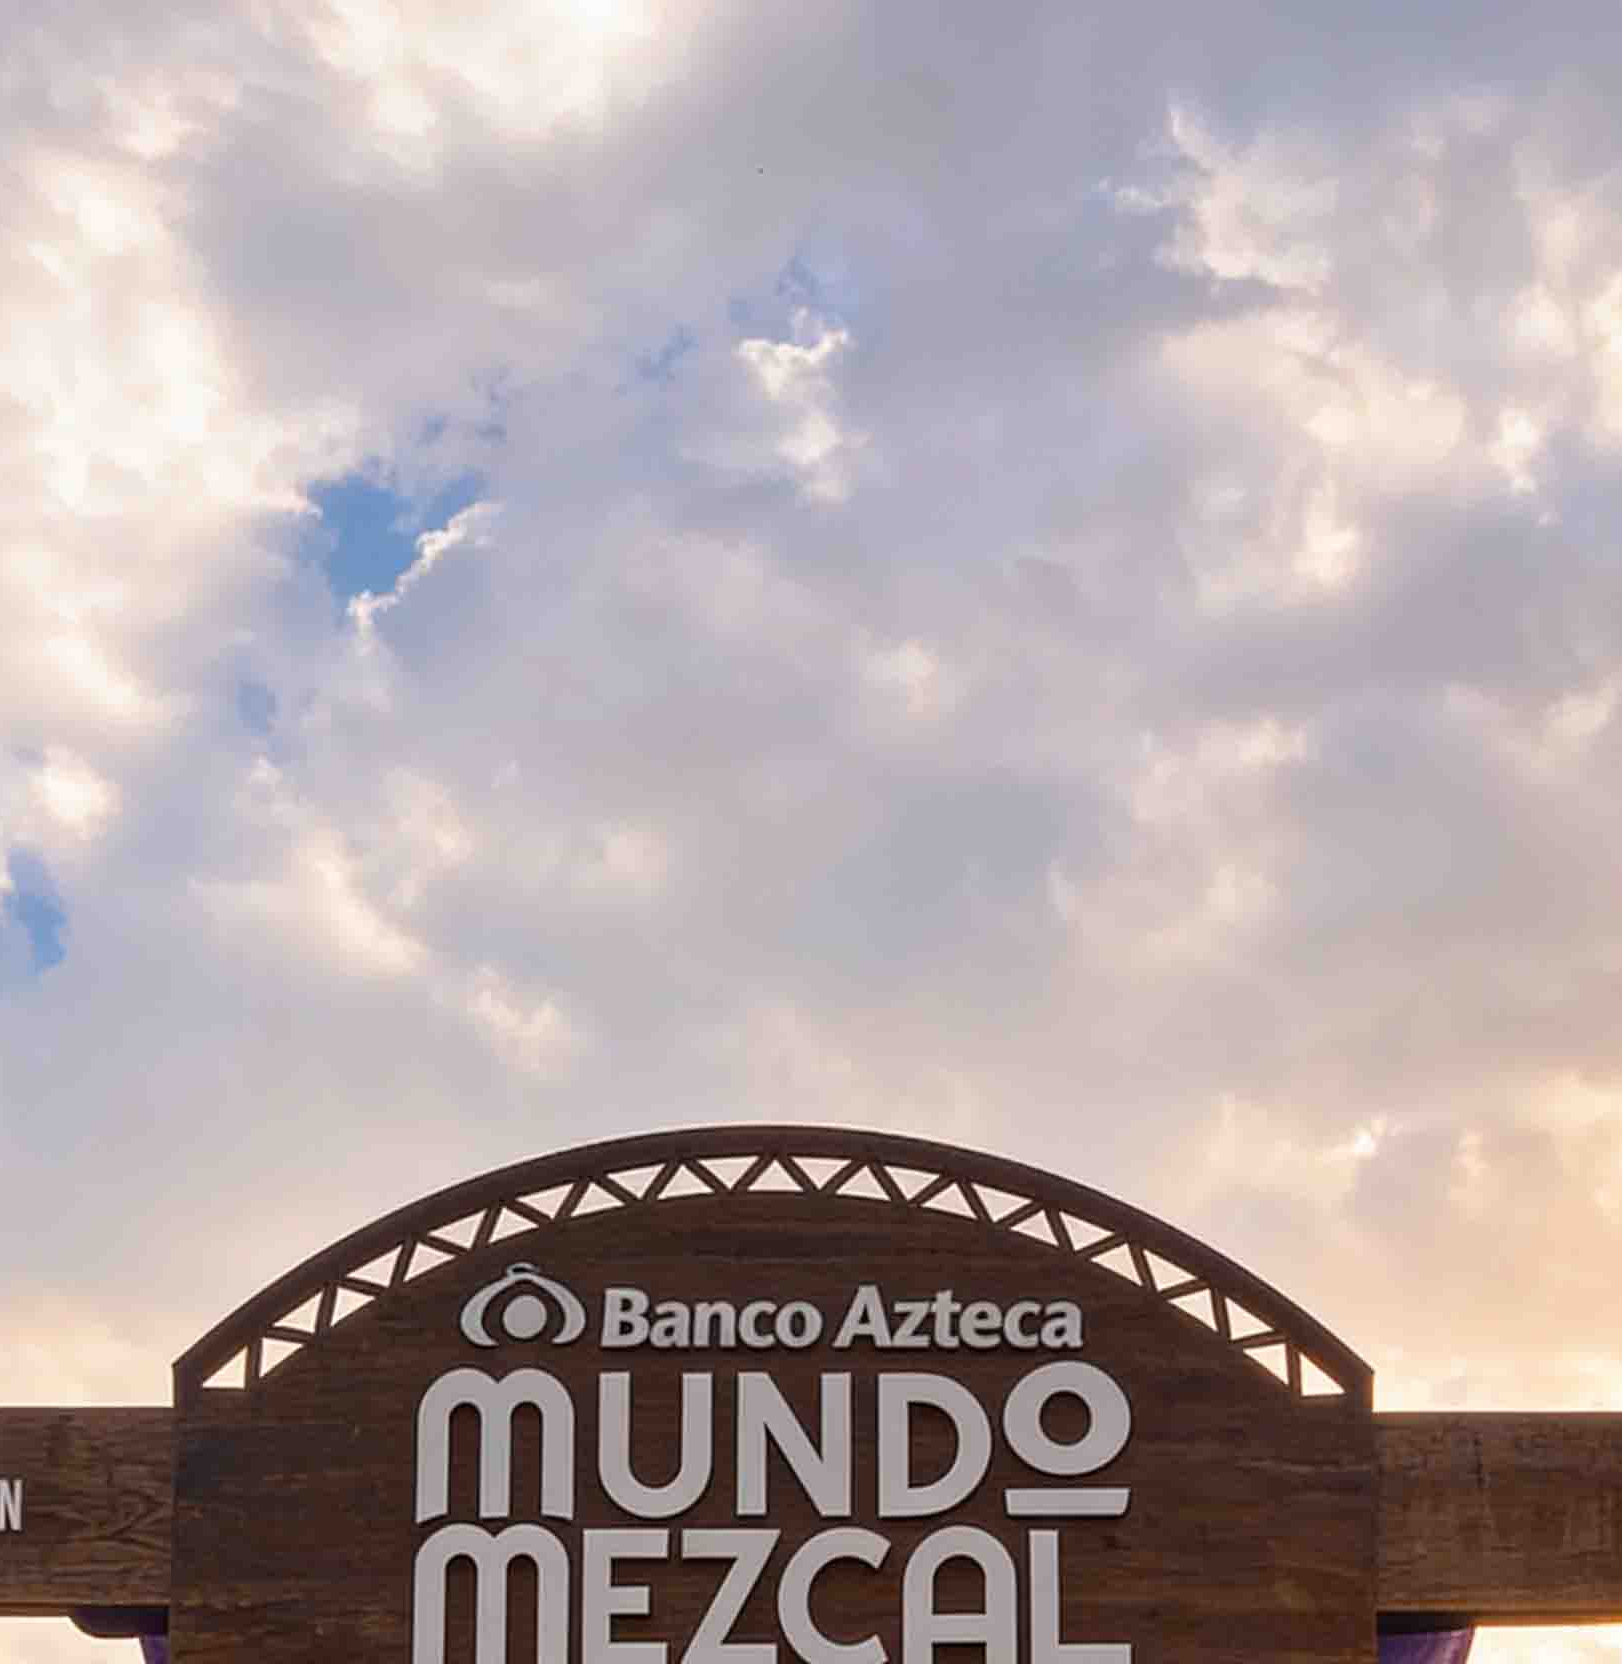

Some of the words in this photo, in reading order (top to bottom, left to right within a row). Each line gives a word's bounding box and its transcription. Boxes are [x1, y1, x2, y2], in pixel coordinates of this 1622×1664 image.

[600, 1286, 822, 1348] Banco
[832, 1284, 1084, 1348] Azteca
[415, 1361, 1132, 1523] MUNDO
